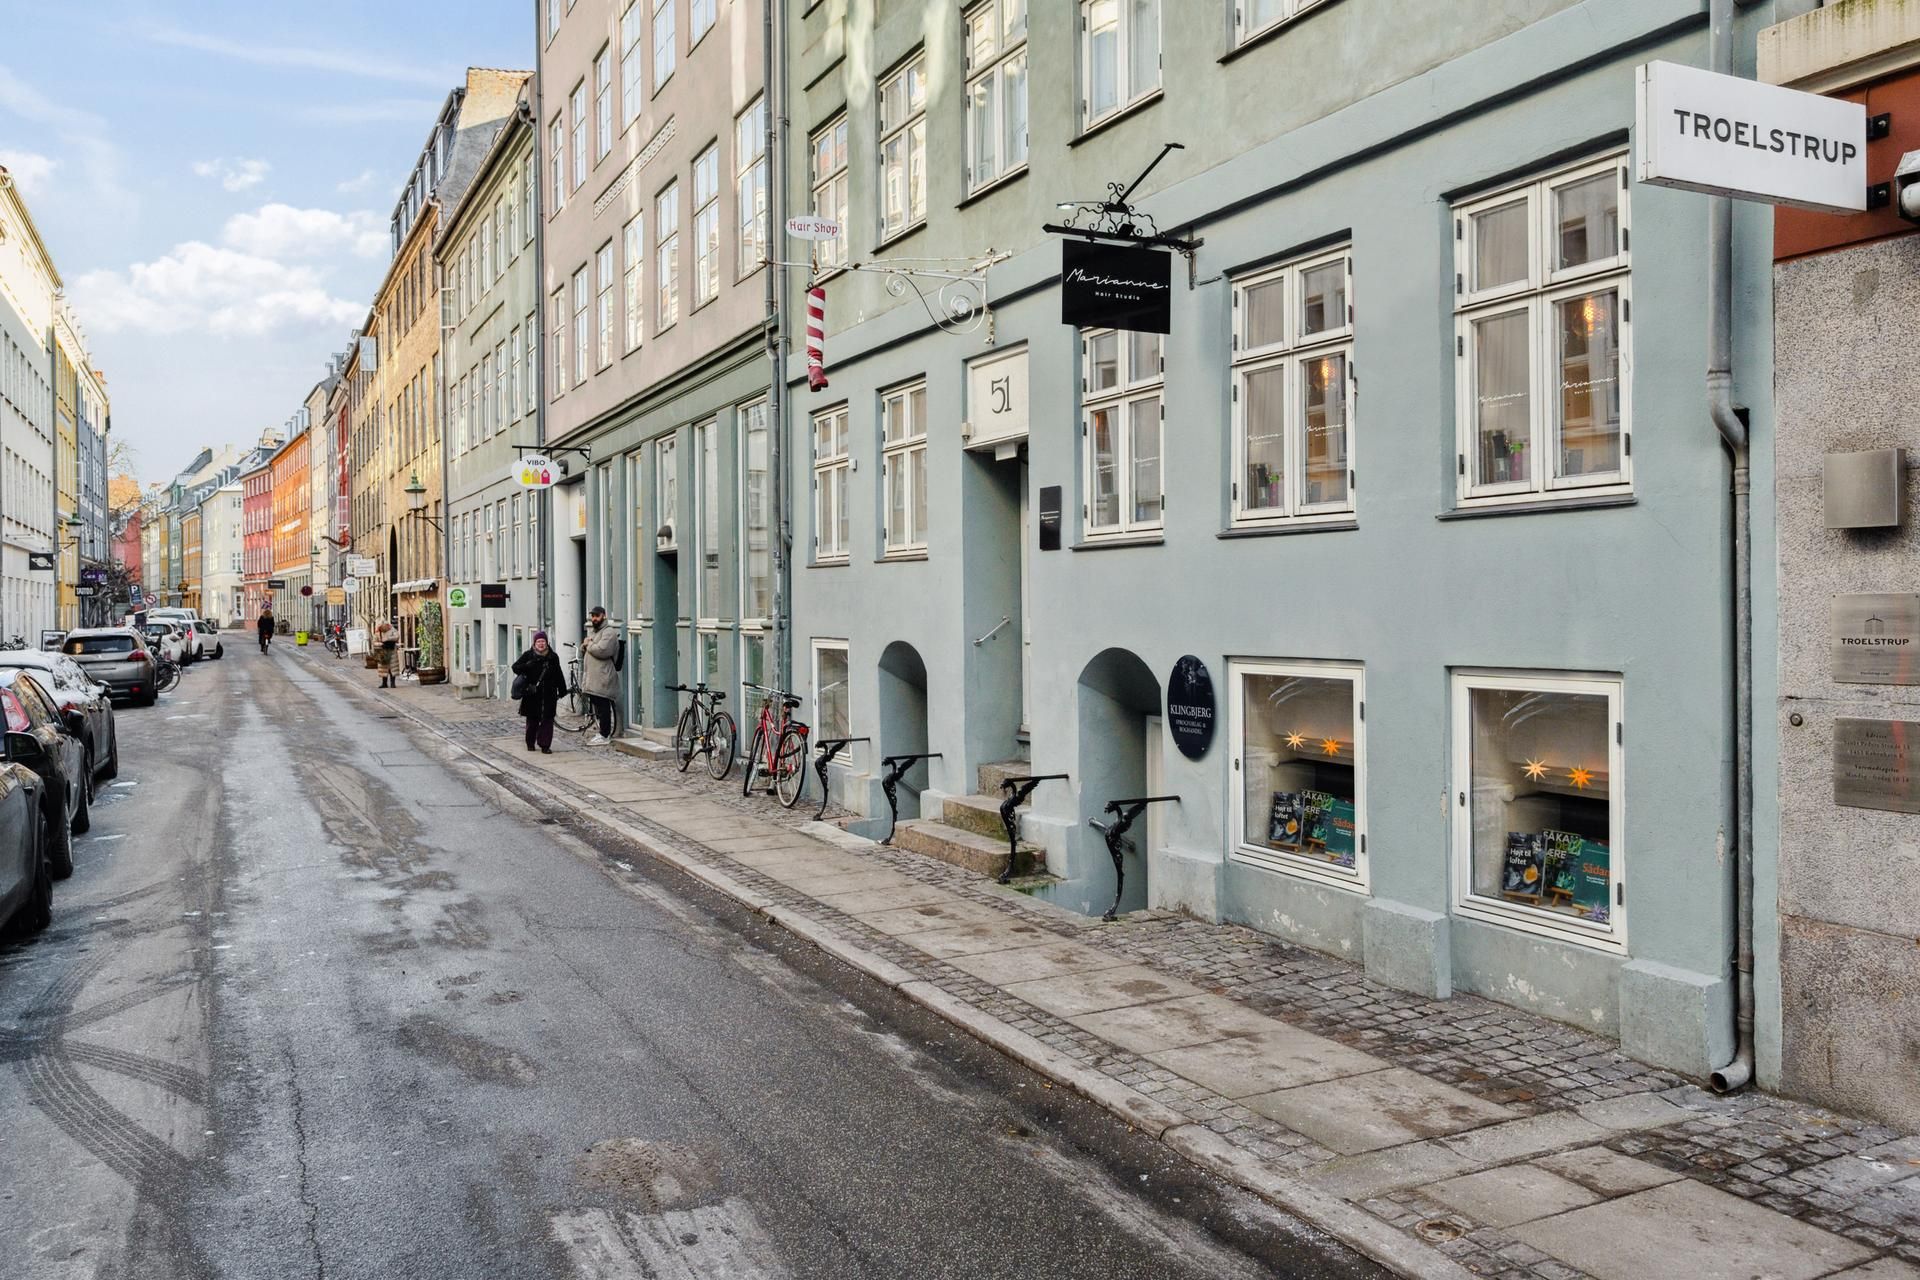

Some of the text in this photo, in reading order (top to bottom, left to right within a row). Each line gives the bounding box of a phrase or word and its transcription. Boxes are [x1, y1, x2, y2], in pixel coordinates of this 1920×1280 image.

[1673, 108, 1857, 165] TROELSTRUP
[789, 221, 838, 236] Hair Shop
[1115, 293, 1140, 301] Studio
[991, 375, 1012, 414] 51
[131, 585, 138, 593] P
[1841, 638, 1910, 646] TROELSTRUP
[1170, 704, 1212, 719] KLINGBJERG
[1510, 848, 1523, 857] Højt
[1509, 857, 1527, 865] loftet
